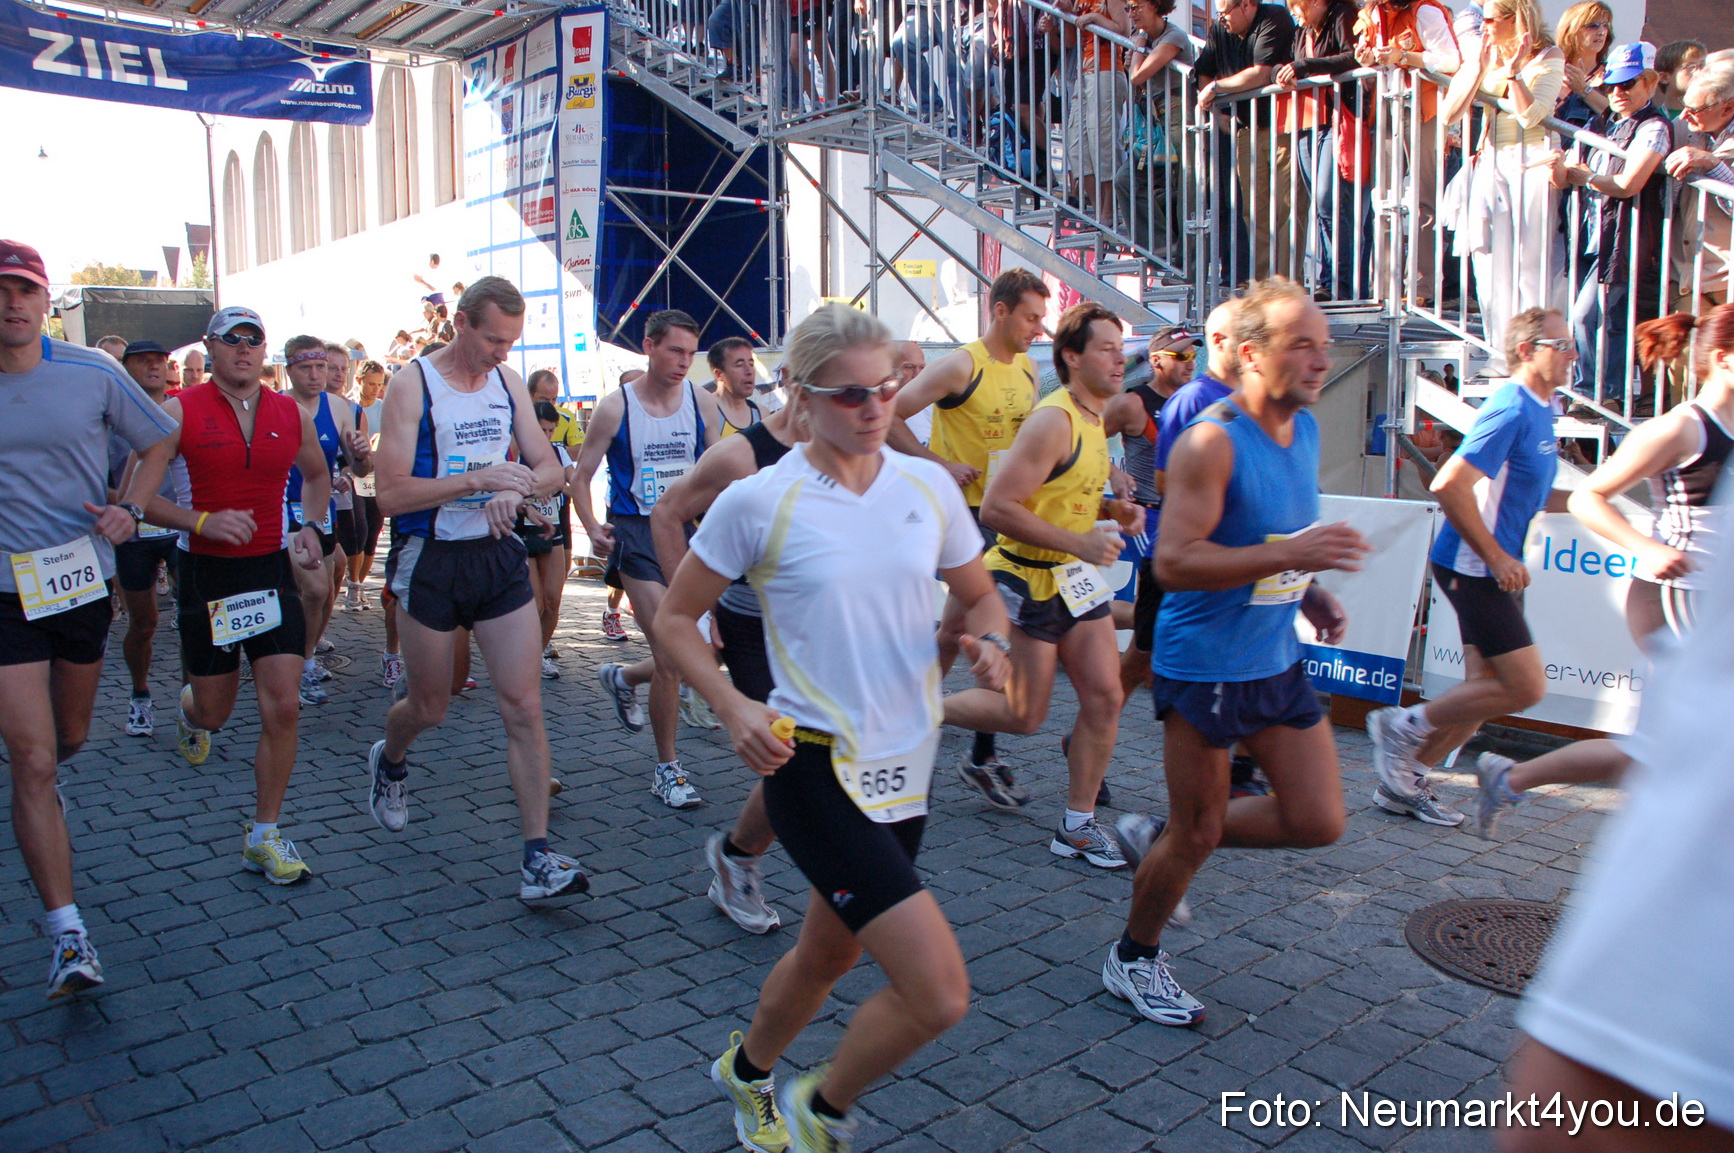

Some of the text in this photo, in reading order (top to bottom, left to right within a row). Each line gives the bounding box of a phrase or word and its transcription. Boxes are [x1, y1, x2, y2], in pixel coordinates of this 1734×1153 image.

[28, 27, 188, 91] ZIEL
[454, 418, 501, 431] Lebenshilfe
[455, 428, 502, 440] Werkstätten
[644, 441, 686, 451] Lebenshilfe
[467, 461, 493, 472] Albert
[656, 469, 684, 479] Thomas
[43, 552, 75, 566] Stefan
[47, 565, 95, 595] 1078
[1071, 578, 1094, 599] 335
[227, 597, 265, 612] michael
[231, 612, 265, 630] 826
[861, 766, 906, 797] 665
